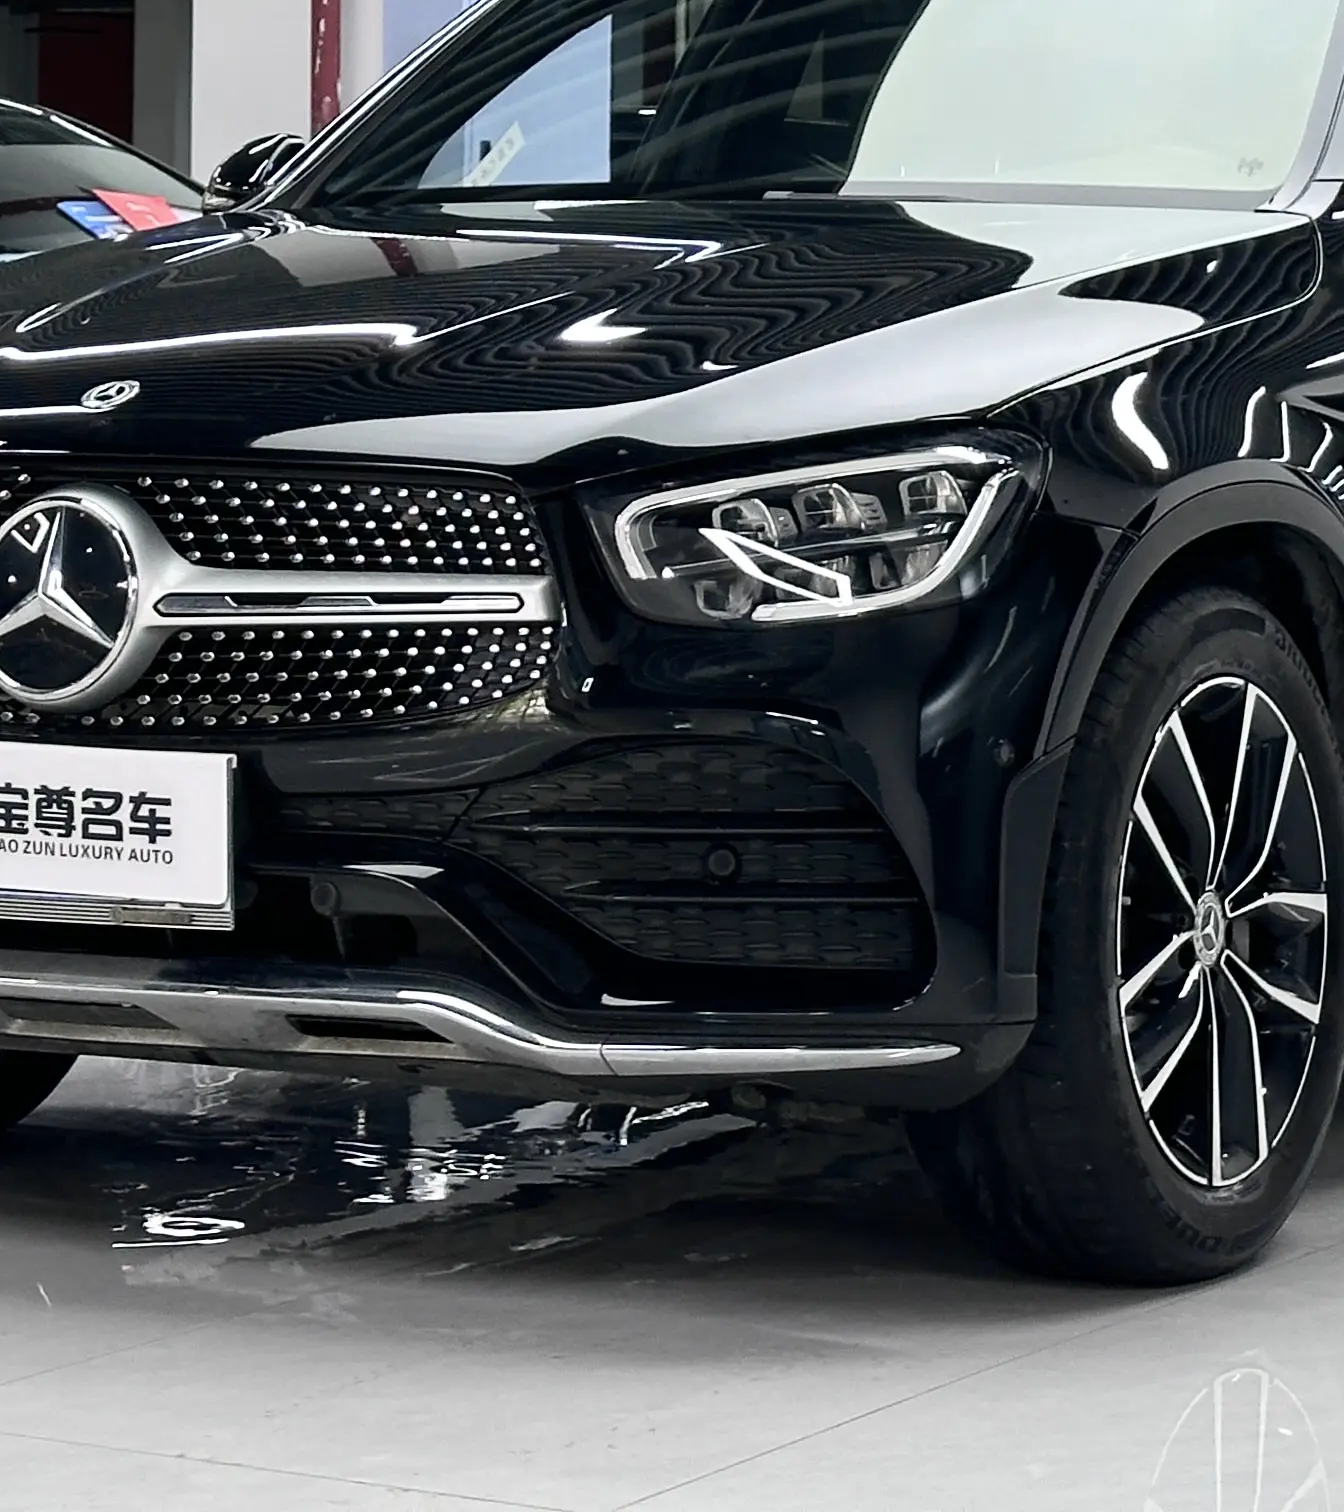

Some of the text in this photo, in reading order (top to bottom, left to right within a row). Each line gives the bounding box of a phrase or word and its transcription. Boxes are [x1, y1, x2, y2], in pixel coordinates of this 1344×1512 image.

[22, 841, 56, 857] ZUN
[59, 843, 124, 861] LUXURY
[128, 849, 174, 865] AUTO
